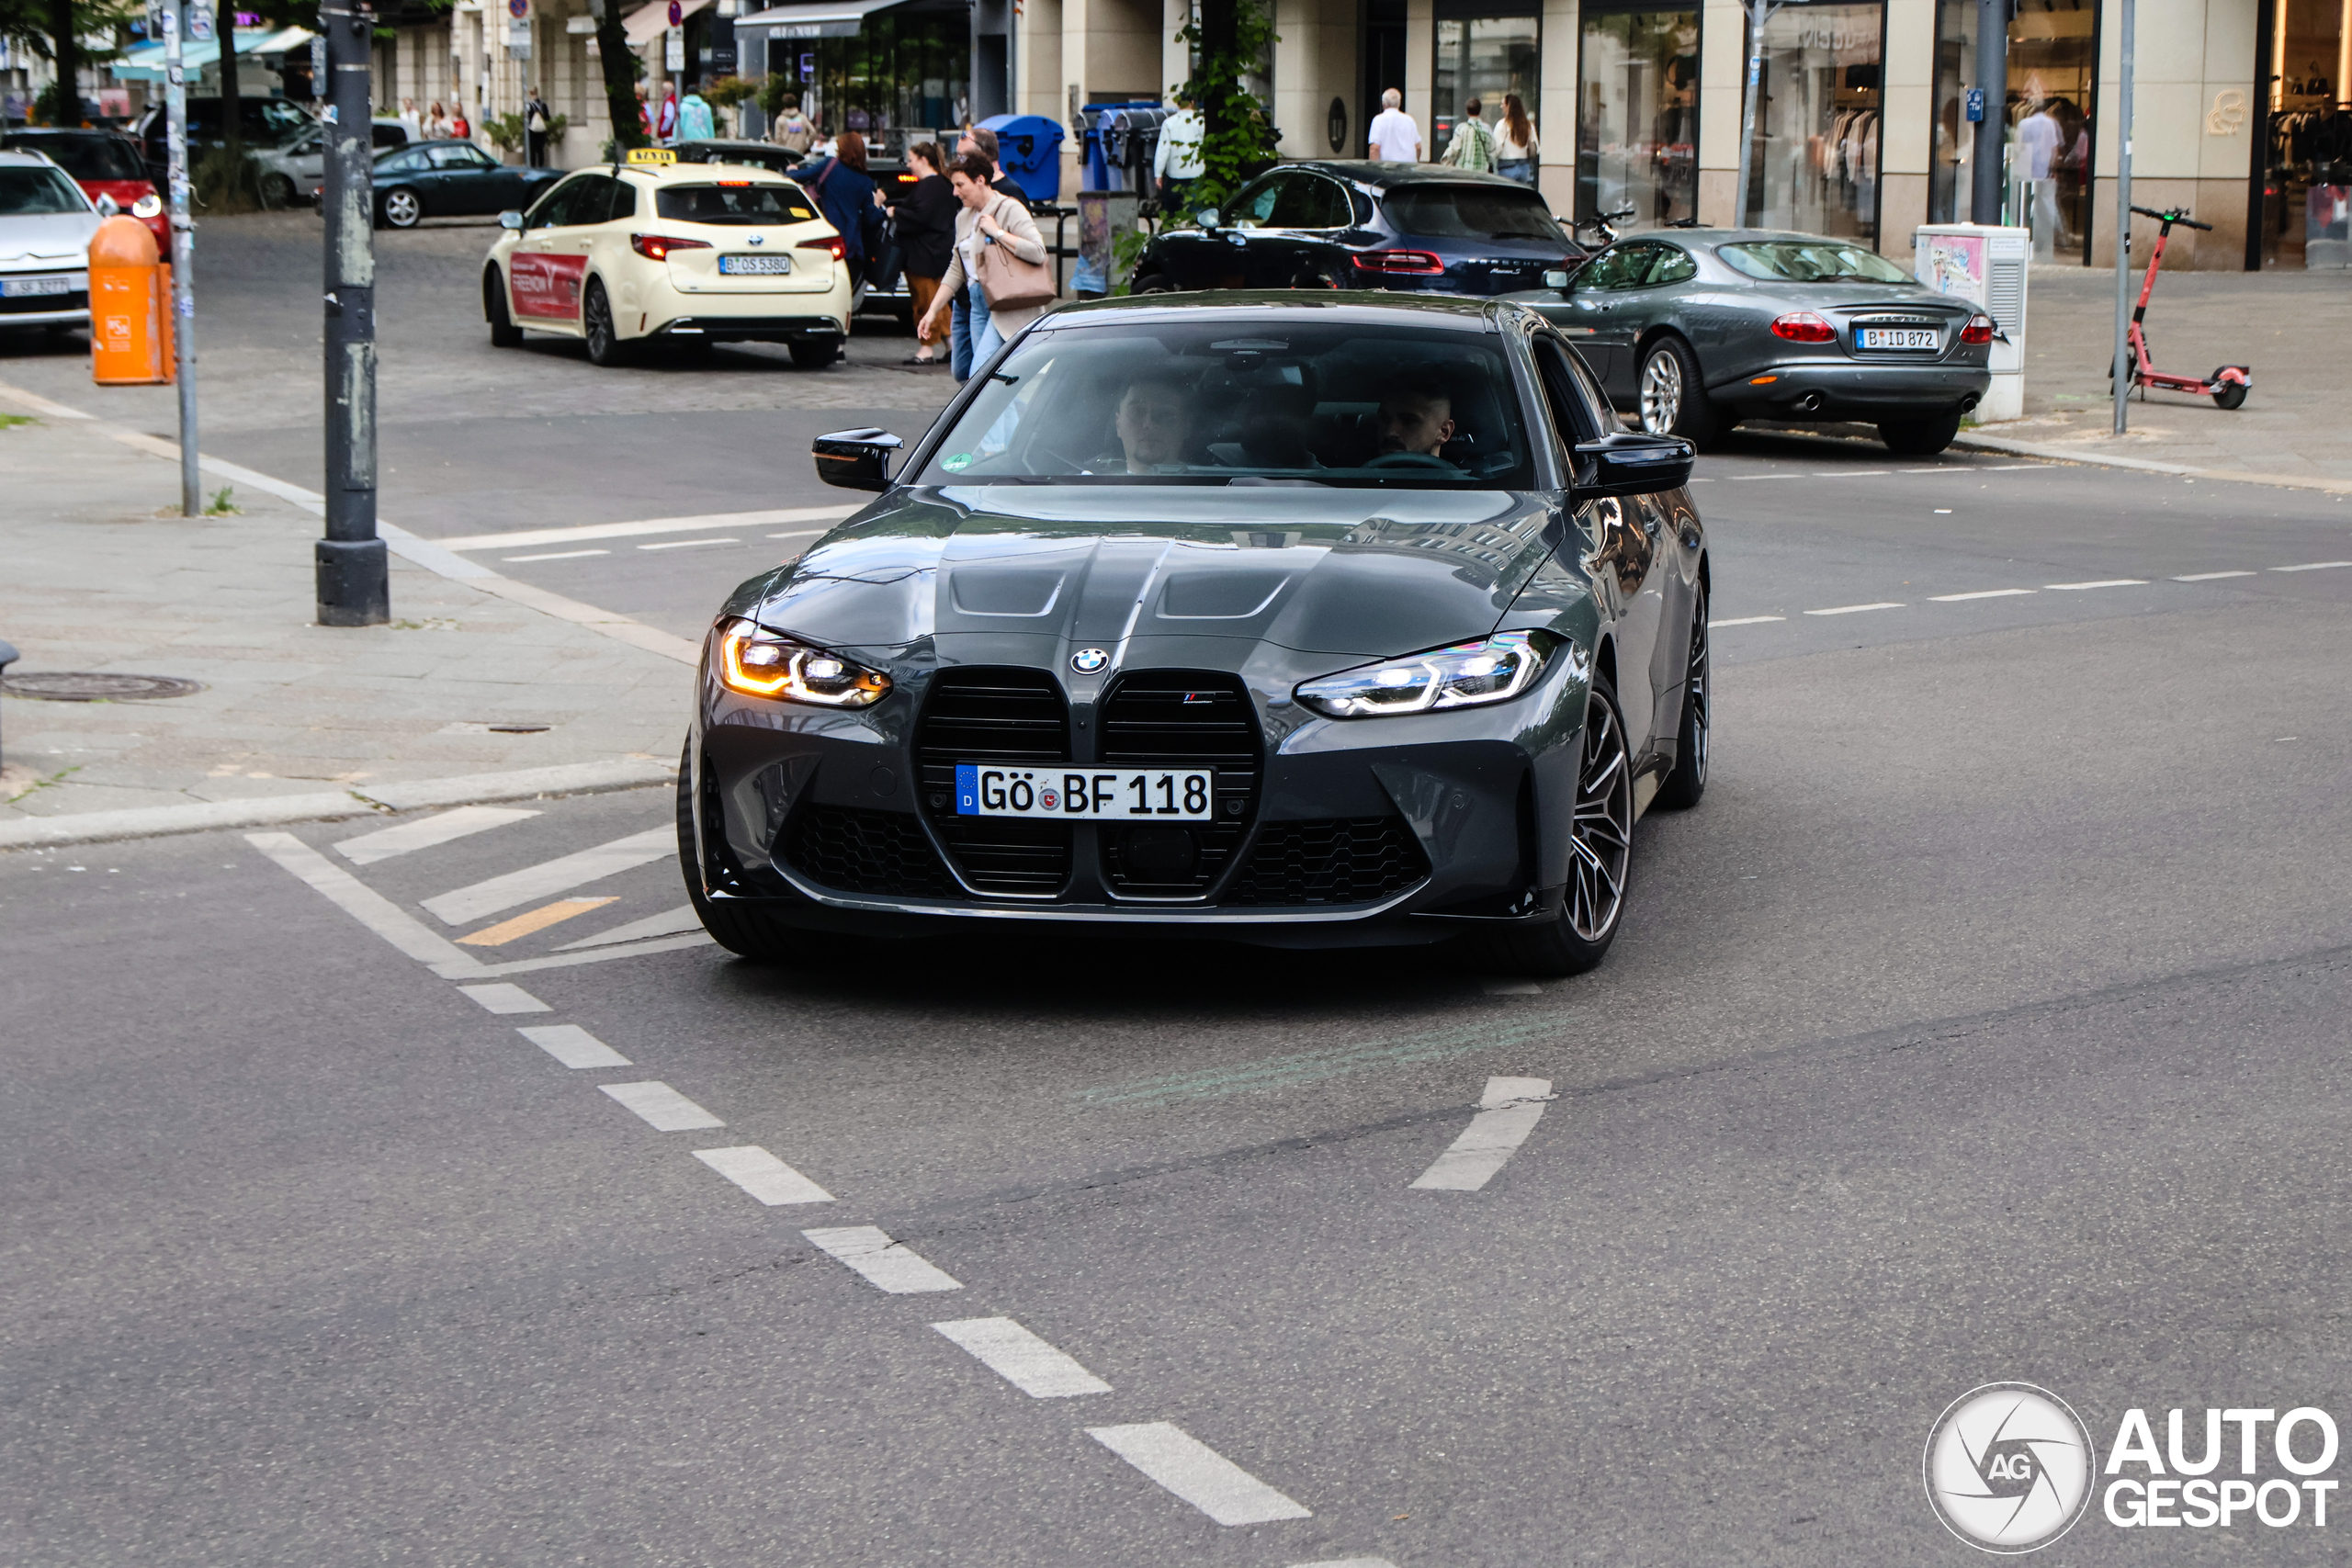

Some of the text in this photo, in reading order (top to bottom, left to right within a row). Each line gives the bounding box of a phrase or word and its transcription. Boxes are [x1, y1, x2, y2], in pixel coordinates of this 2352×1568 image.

[726, 258, 734, 270] B
[759, 258, 787, 270] 5380
[1468, 258, 1541, 267] PORSCHE
[1869, 332, 1934, 347] B ID 872
[964, 771, 1207, 814] D GÖ BF 118
